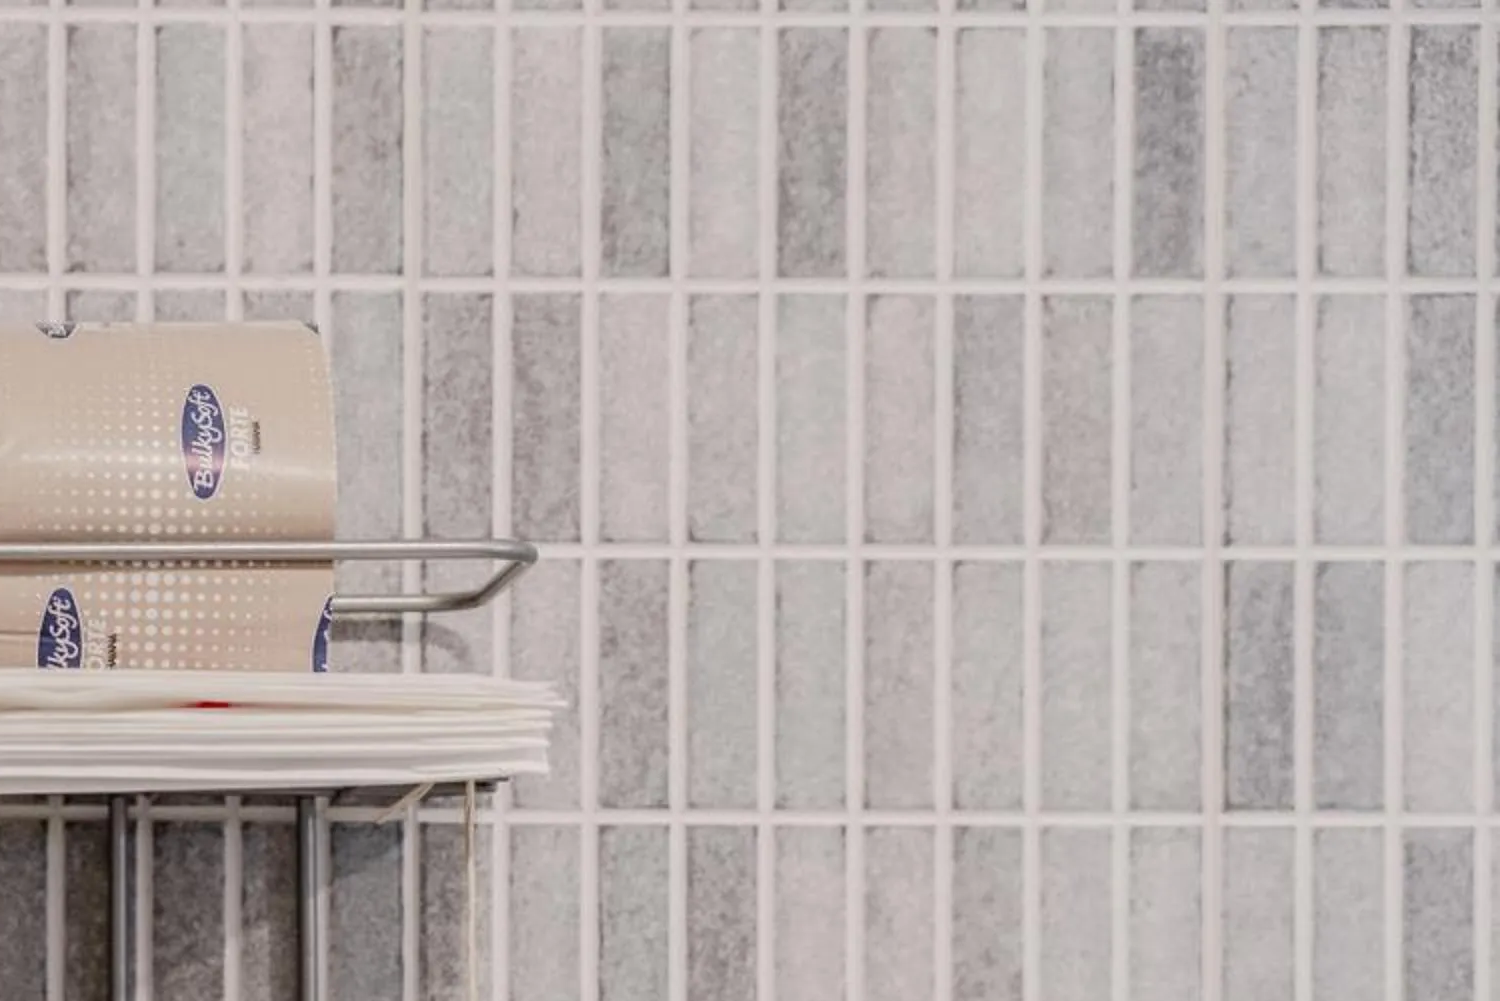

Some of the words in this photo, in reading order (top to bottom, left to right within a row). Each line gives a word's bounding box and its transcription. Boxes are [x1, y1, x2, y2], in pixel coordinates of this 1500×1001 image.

[187, 392, 222, 490] BulkySoft
[229, 405, 250, 472] FORTE
[85, 623, 107, 669] ORTE
